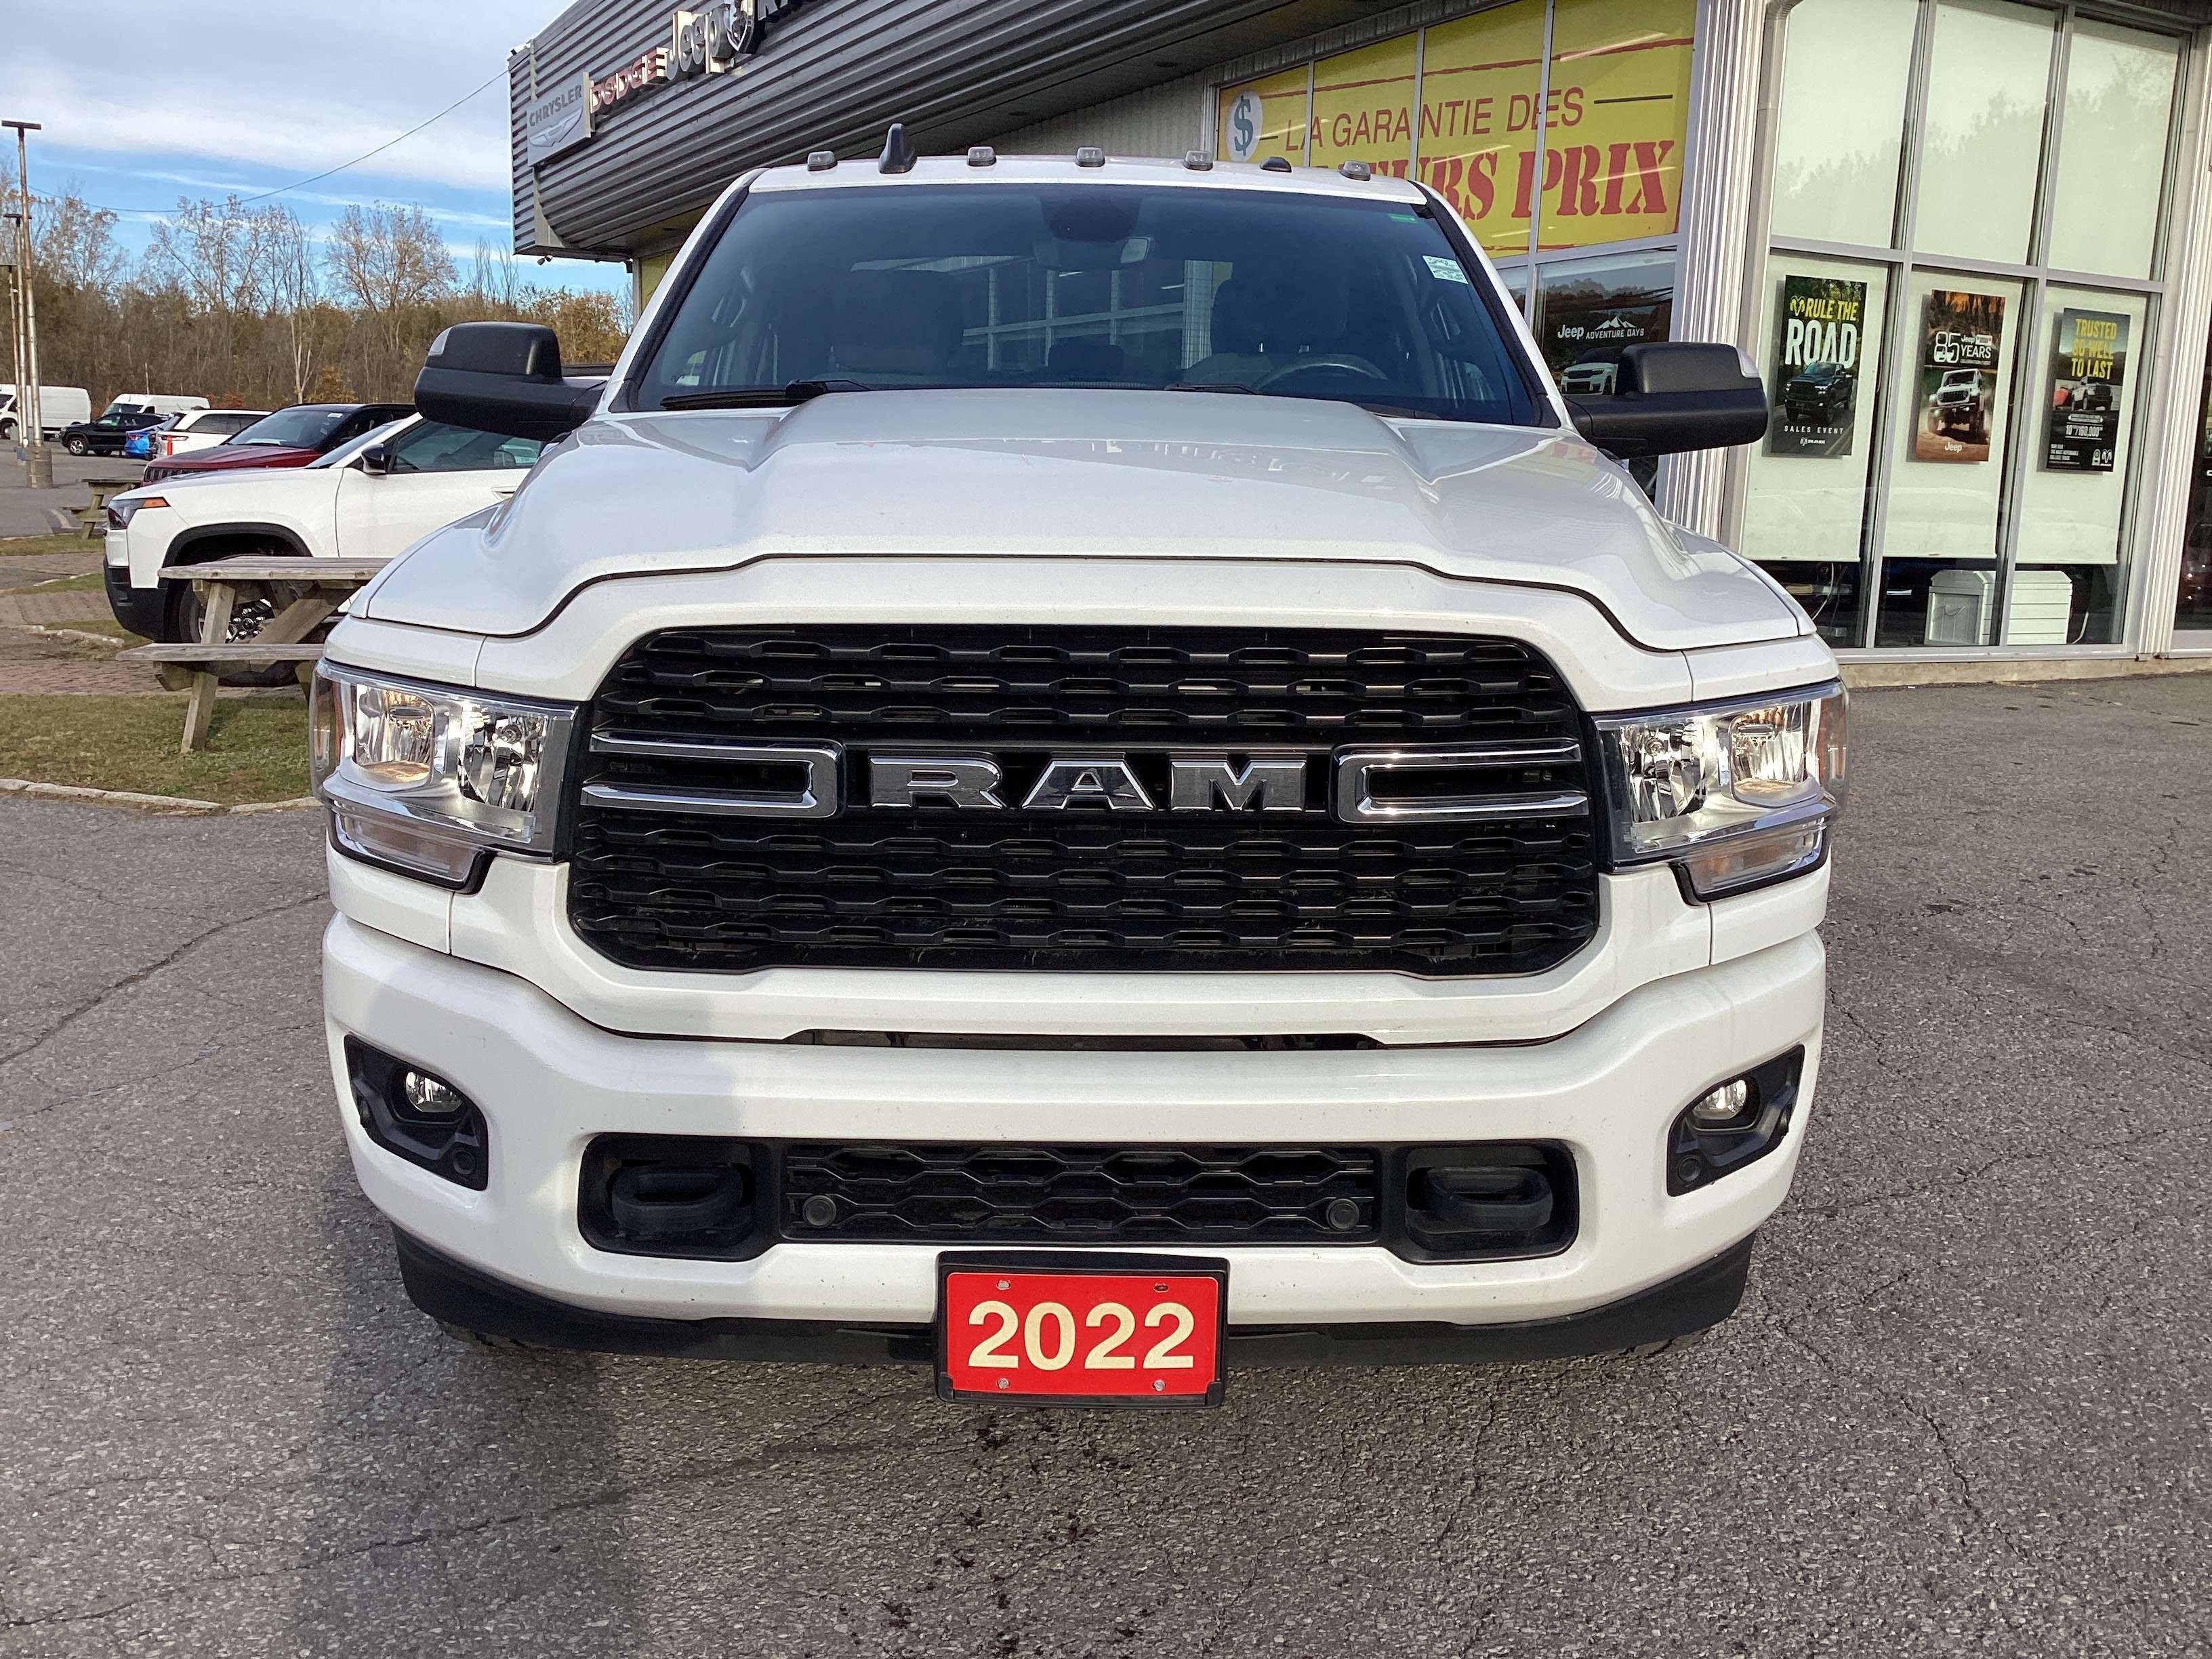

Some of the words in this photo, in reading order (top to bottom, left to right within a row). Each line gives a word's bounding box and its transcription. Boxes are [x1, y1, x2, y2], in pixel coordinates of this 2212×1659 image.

[666, 5, 728, 80] Jeep
[590, 48, 665, 113] DODGE
[529, 84, 582, 127] CHRYSLER
[1285, 117, 1324, 151] LA
[1332, 97, 1494, 147] GARANTIE
[1507, 86, 1584, 132] DES
[1511, 140, 1675, 218] PRIX
[1805, 298, 1834, 320] RULE
[1837, 299, 1859, 321] THE
[1557, 325, 1584, 340] Jeep
[1586, 329, 1624, 340] ADVENTURE
[1626, 328, 1645, 337] DAYS
[1785, 318, 1858, 369] ROAD
[1934, 331, 1961, 363] 85
[2076, 319, 2117, 340] TRUSTED
[1961, 344, 1992, 359] YEARS
[2071, 358, 2085, 377] TO
[2087, 359, 2114, 380] LAST
[1784, 425, 1811, 433] SALES
[1818, 426, 1844, 434] EVENT
[1944, 442, 1963, 453] Jeep
[869, 750, 1307, 811] RAM
[968, 1300, 1195, 1371] 2022
